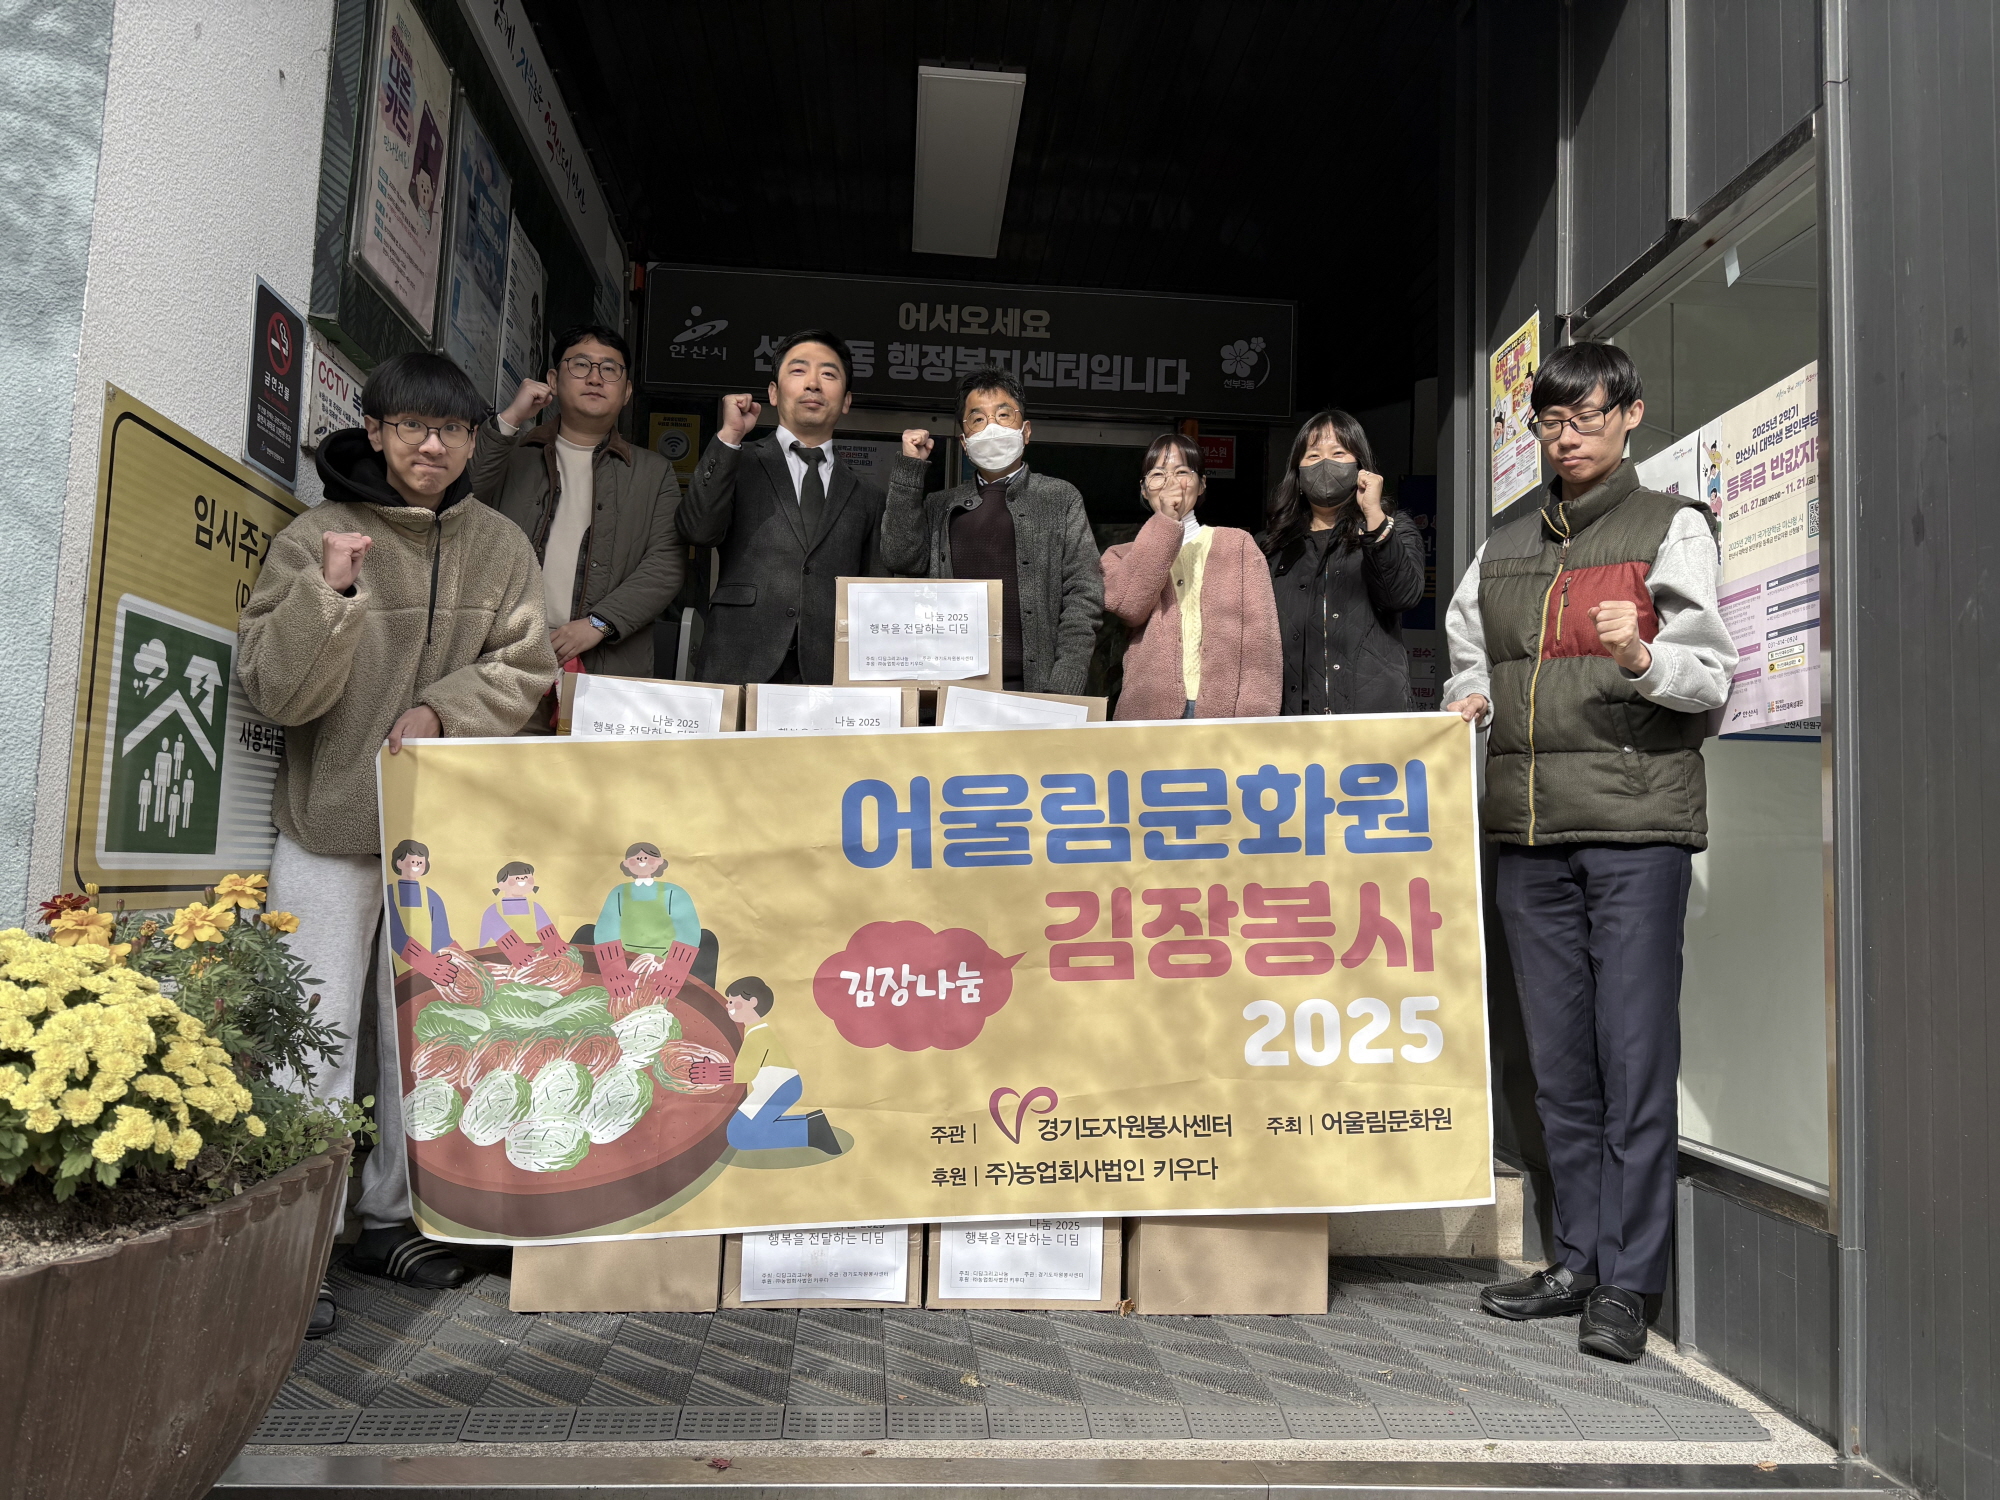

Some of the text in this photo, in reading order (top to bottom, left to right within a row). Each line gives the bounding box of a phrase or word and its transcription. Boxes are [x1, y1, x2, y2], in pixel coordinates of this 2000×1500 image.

[571, 171, 587, 214] 안산
[898, 302, 1051, 339] 어서오세요
[669, 344, 727, 361] 안산시
[319, 360, 349, 402] CCTV
[888, 341, 1190, 395] 행정복지센터입니다
[265, 371, 289, 402] 금연건물
[1223, 379, 1255, 390] 선부3동
[1752, 403, 1799, 440] 2025년 2학기
[1736, 443, 1758, 465] 안산시
[1759, 430, 1784, 455] 대학생
[1727, 437, 1819, 502] 등록금 반값지
[1744, 533, 1757, 544] 2학기
[1757, 523, 1782, 539] 국가장학금
[869, 623, 969, 635] 행복을 전달하는 디딤
[925, 611, 969, 622] 나눔 2025
[593, 721, 626, 735] 행복을
[652, 714, 699, 729] 나눔 2025
[835, 715, 881, 727] 나눔 2025
[1742, 709, 1759, 718] 안산시
[842, 759, 1433, 869] 어울림문화원
[1044, 877, 1443, 982] 김장봉사
[840, 961, 984, 1008] 김장나눔
[1243, 995, 1444, 1067] 2025
[930, 1107, 1452, 1144] 주관 경기도자원봉사센터 주최 어울림문화원
[931, 1158, 1219, 1188] 후원 주)농업회사법인 키우다
[768, 1231, 884, 1246] 행복을 전달하는 디딤
[965, 1231, 1079, 1247] 행복을 전달하는 디딤
[1029, 1218, 1080, 1231] 나눔 2025
